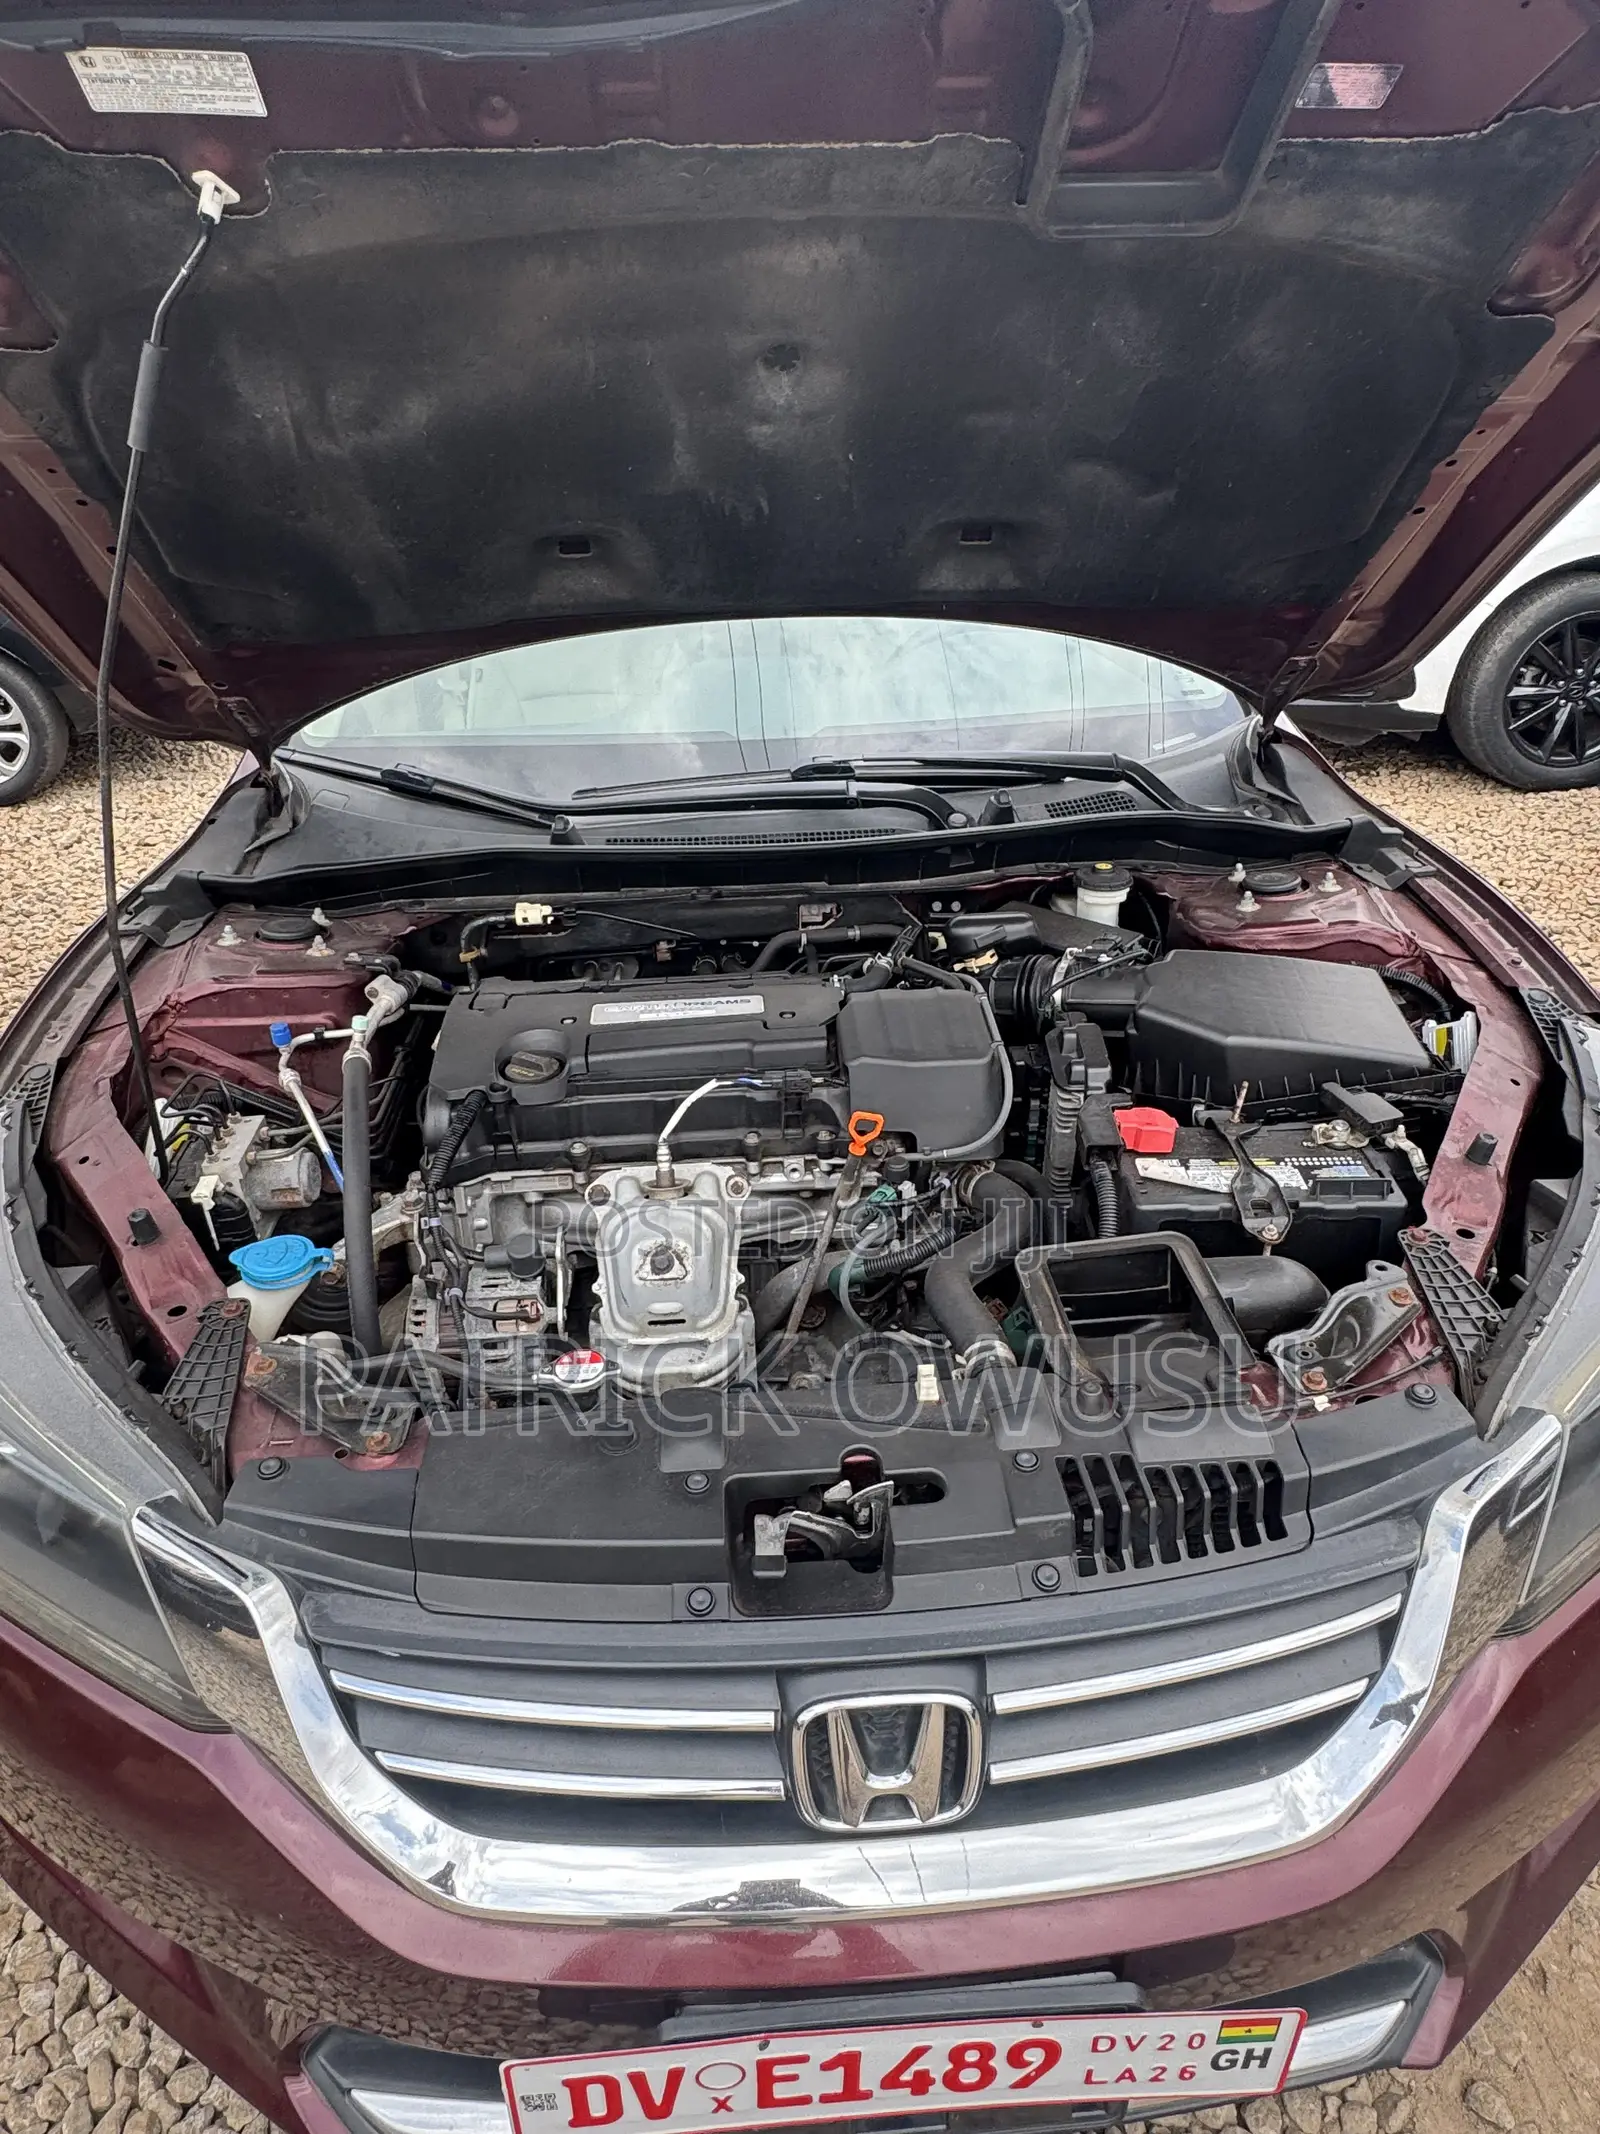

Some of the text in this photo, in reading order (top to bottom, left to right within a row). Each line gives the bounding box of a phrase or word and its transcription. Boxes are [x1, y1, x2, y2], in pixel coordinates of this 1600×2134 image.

[561, 2066, 686, 2128] DV
[756, 2037, 1063, 2109] E1489
[1210, 2047, 1273, 2072] GH
